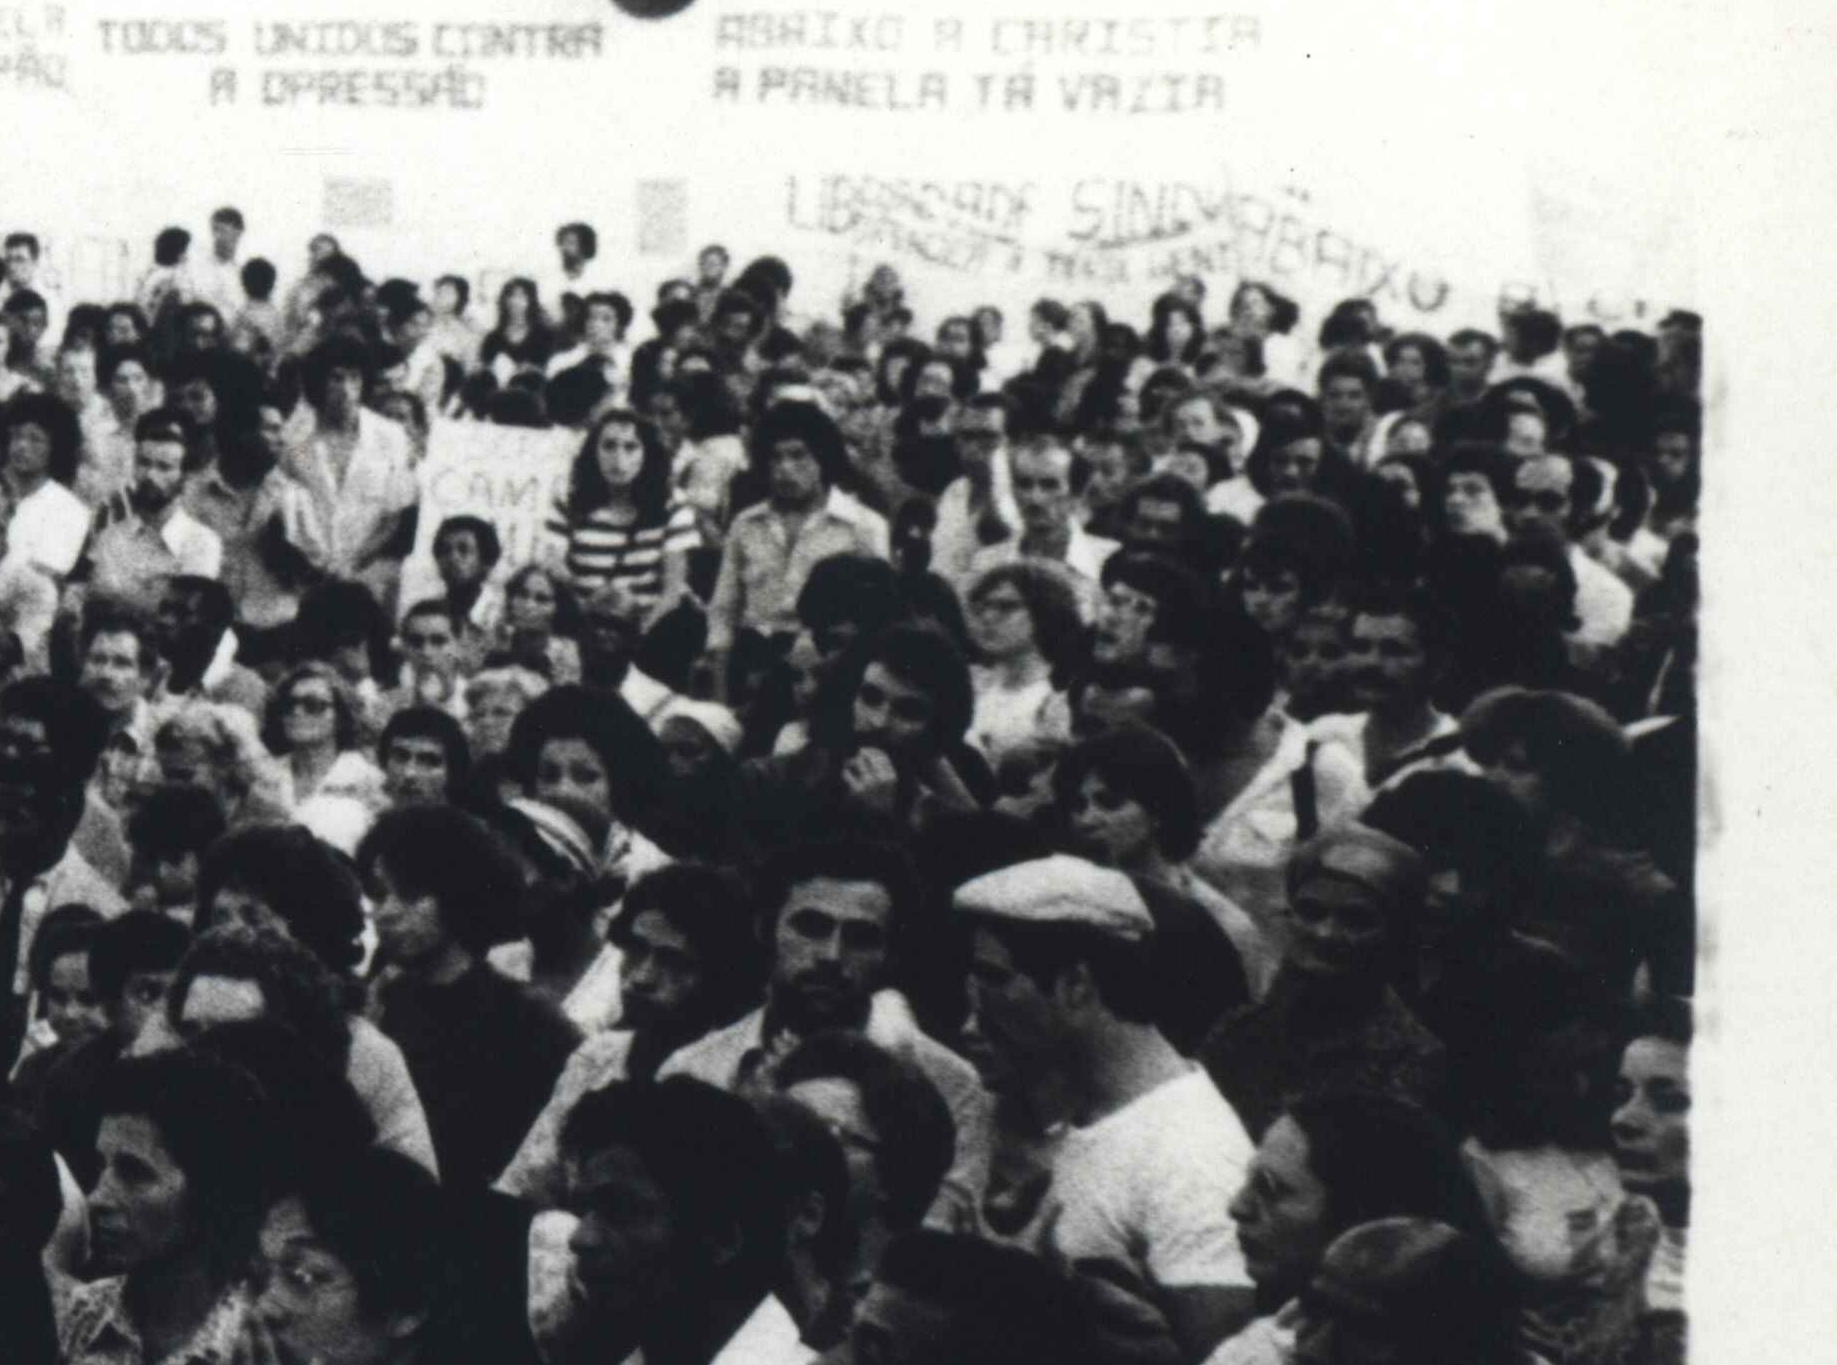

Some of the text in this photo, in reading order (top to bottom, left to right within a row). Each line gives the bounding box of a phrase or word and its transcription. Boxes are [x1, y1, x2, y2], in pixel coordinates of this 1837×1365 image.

[96, 17, 605, 59] TODOS UNIDOS CONTRA
[714, 9, 906, 53] ABAIXO
[209, 66, 238, 107] A
[712, 65, 742, 102] A
[757, 65, 949, 113] PANELA
[1057, 71, 1227, 115] VAZIA
